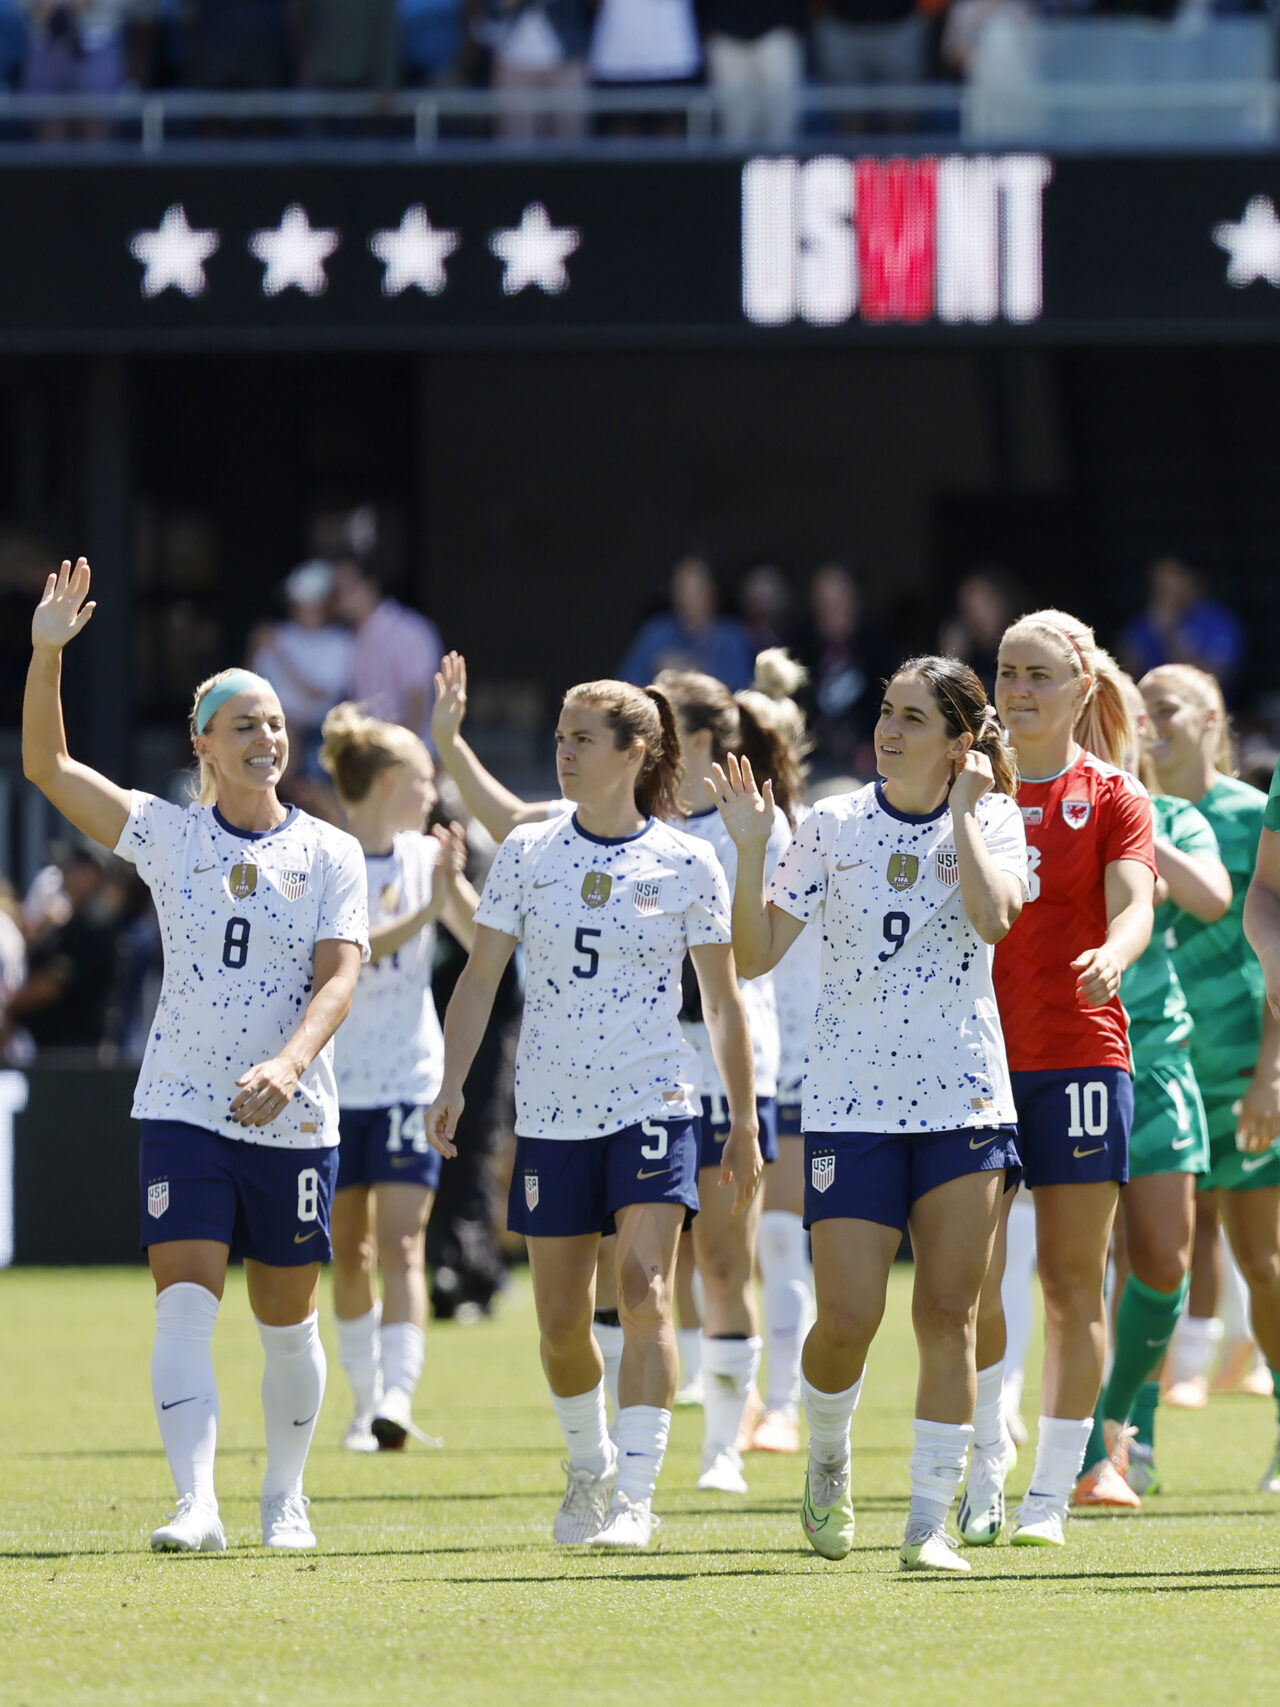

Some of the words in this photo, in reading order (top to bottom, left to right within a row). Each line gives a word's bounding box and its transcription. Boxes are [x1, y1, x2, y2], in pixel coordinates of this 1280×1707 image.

[283, 871, 307, 885] USA
[636, 881, 659, 897] USA
[222, 916, 251, 969] 8
[572, 926, 602, 979] 5
[878, 911, 910, 962] 9
[385, 1104, 430, 1154] 14
[1065, 1081, 1108, 1137] 10
[641, 1120, 669, 1160] 5
[813, 1158, 834, 1173] USA
[150, 1184, 167, 1199] USA
[297, 1167, 318, 1222] 8
